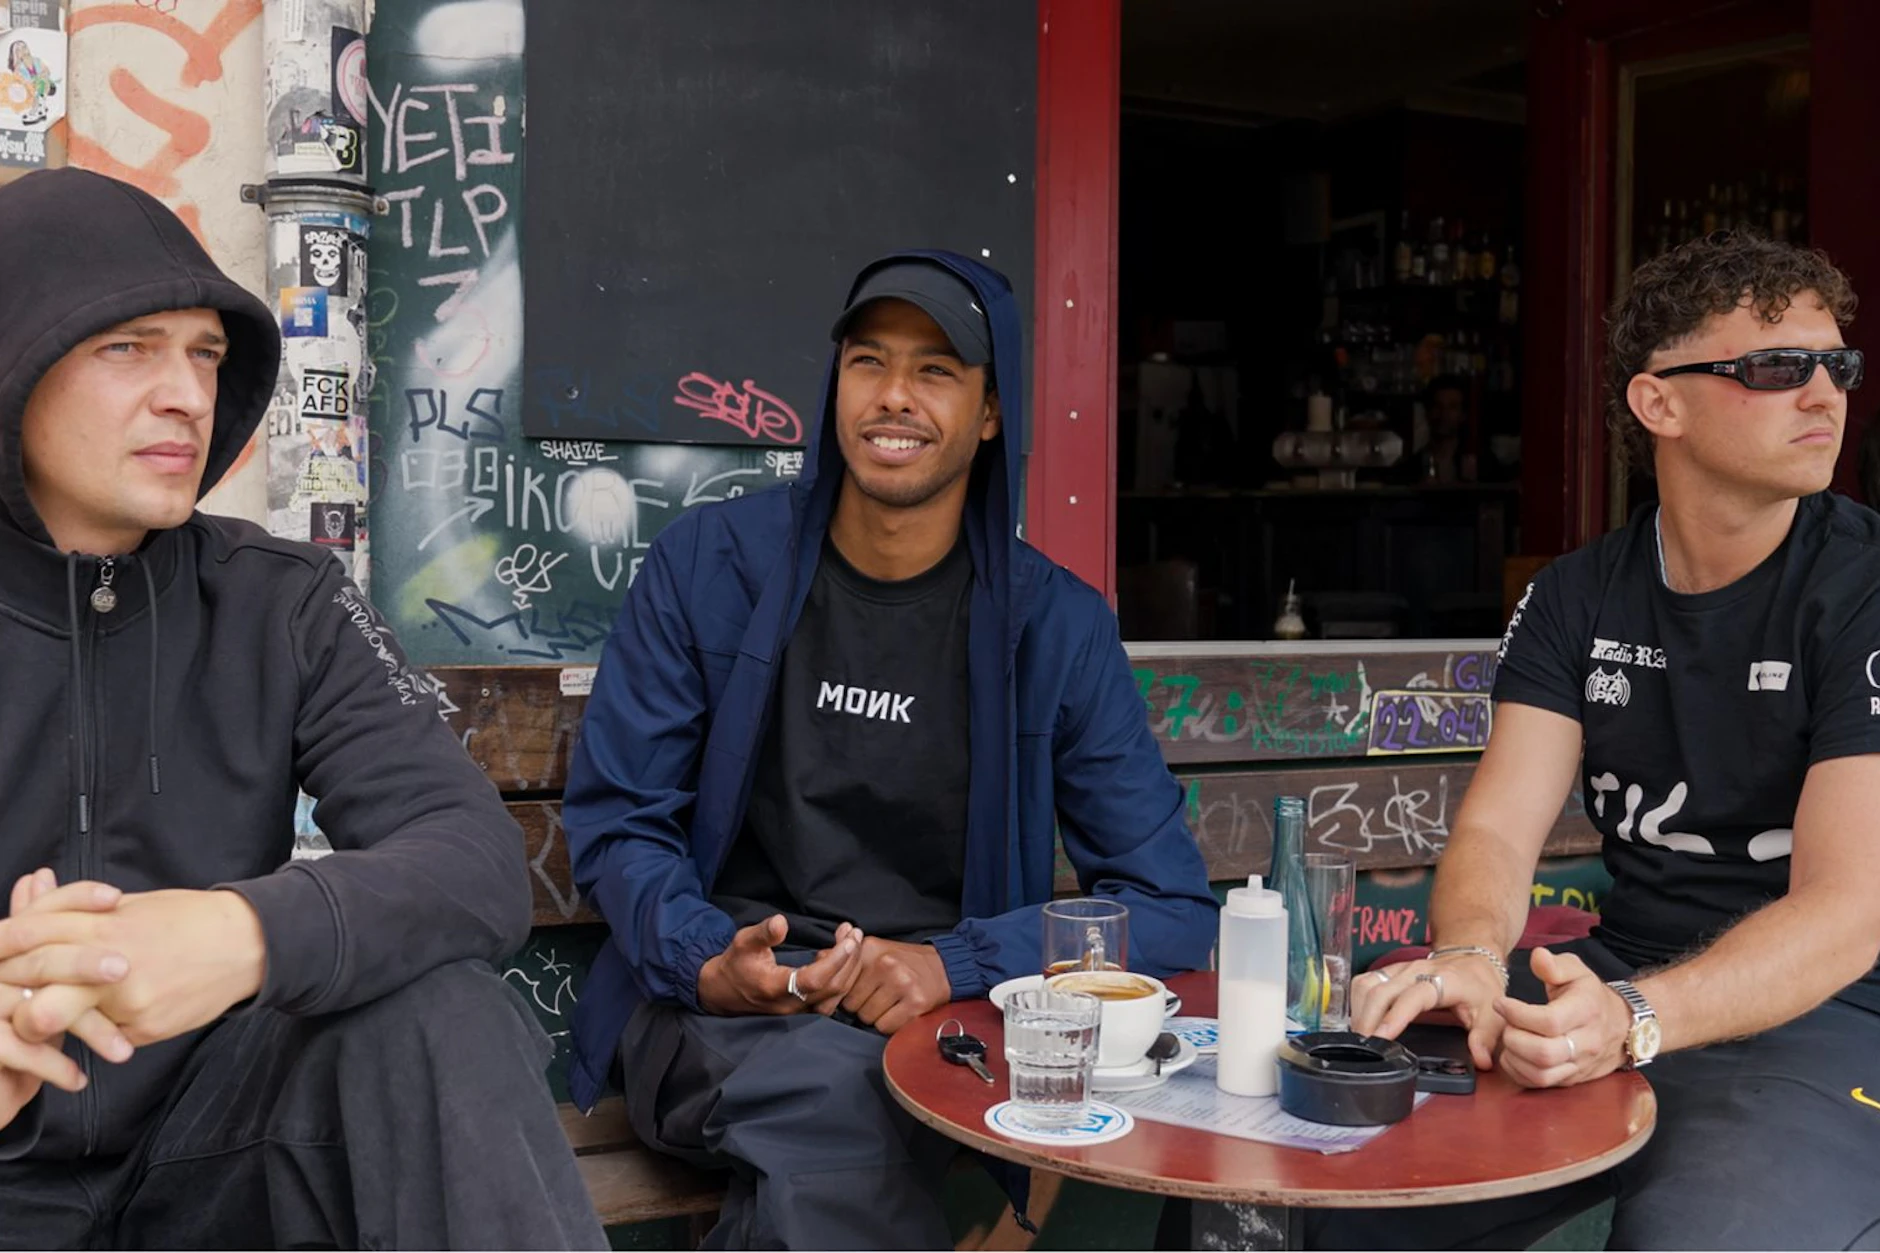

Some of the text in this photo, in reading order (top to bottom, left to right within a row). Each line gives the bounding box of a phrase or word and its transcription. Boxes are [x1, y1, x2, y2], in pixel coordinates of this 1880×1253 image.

[303, 377, 349, 396] FCK
[303, 395, 348, 413] AFD
[1379, 701, 1485, 749] 22.04
